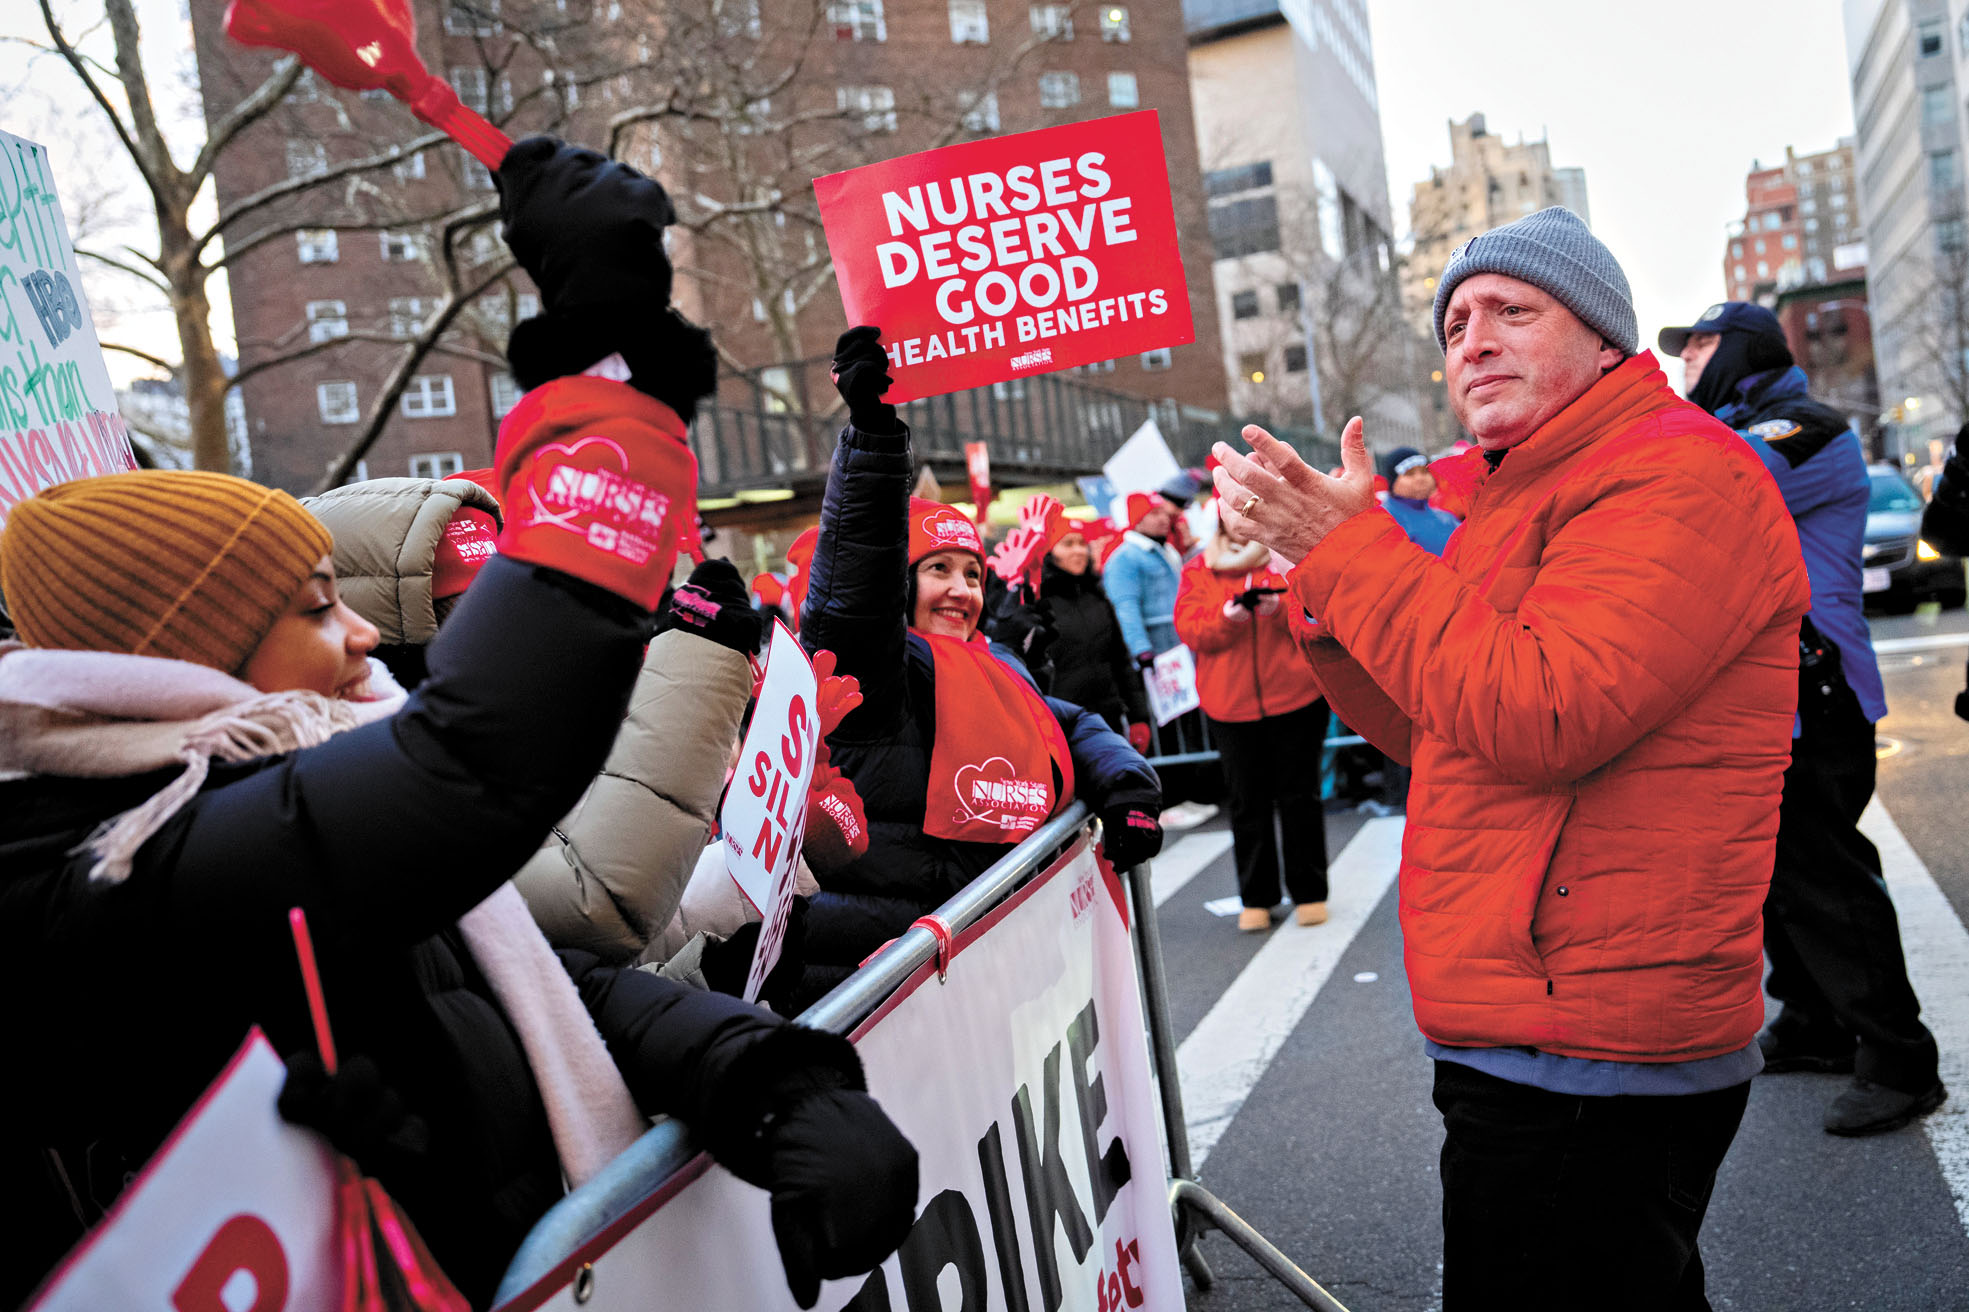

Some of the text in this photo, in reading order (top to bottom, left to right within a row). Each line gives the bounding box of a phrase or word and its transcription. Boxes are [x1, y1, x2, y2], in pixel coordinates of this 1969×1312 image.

[881, 152, 1112, 237] NURSES
[876, 197, 1138, 289] DESERVE
[20, 269, 83, 350] HBO
[935, 255, 1099, 325] GOOD
[1016, 288, 1169, 343] BENEFITS
[882, 321, 1006, 368] HEALTH
[1010, 349, 1052, 368] NURSES
[17, 339, 96, 427] than
[823, 793, 861, 840] NURSES
[971, 798, 1049, 815] ASSOCIATION
[972, 779, 1048, 806] NURSES
